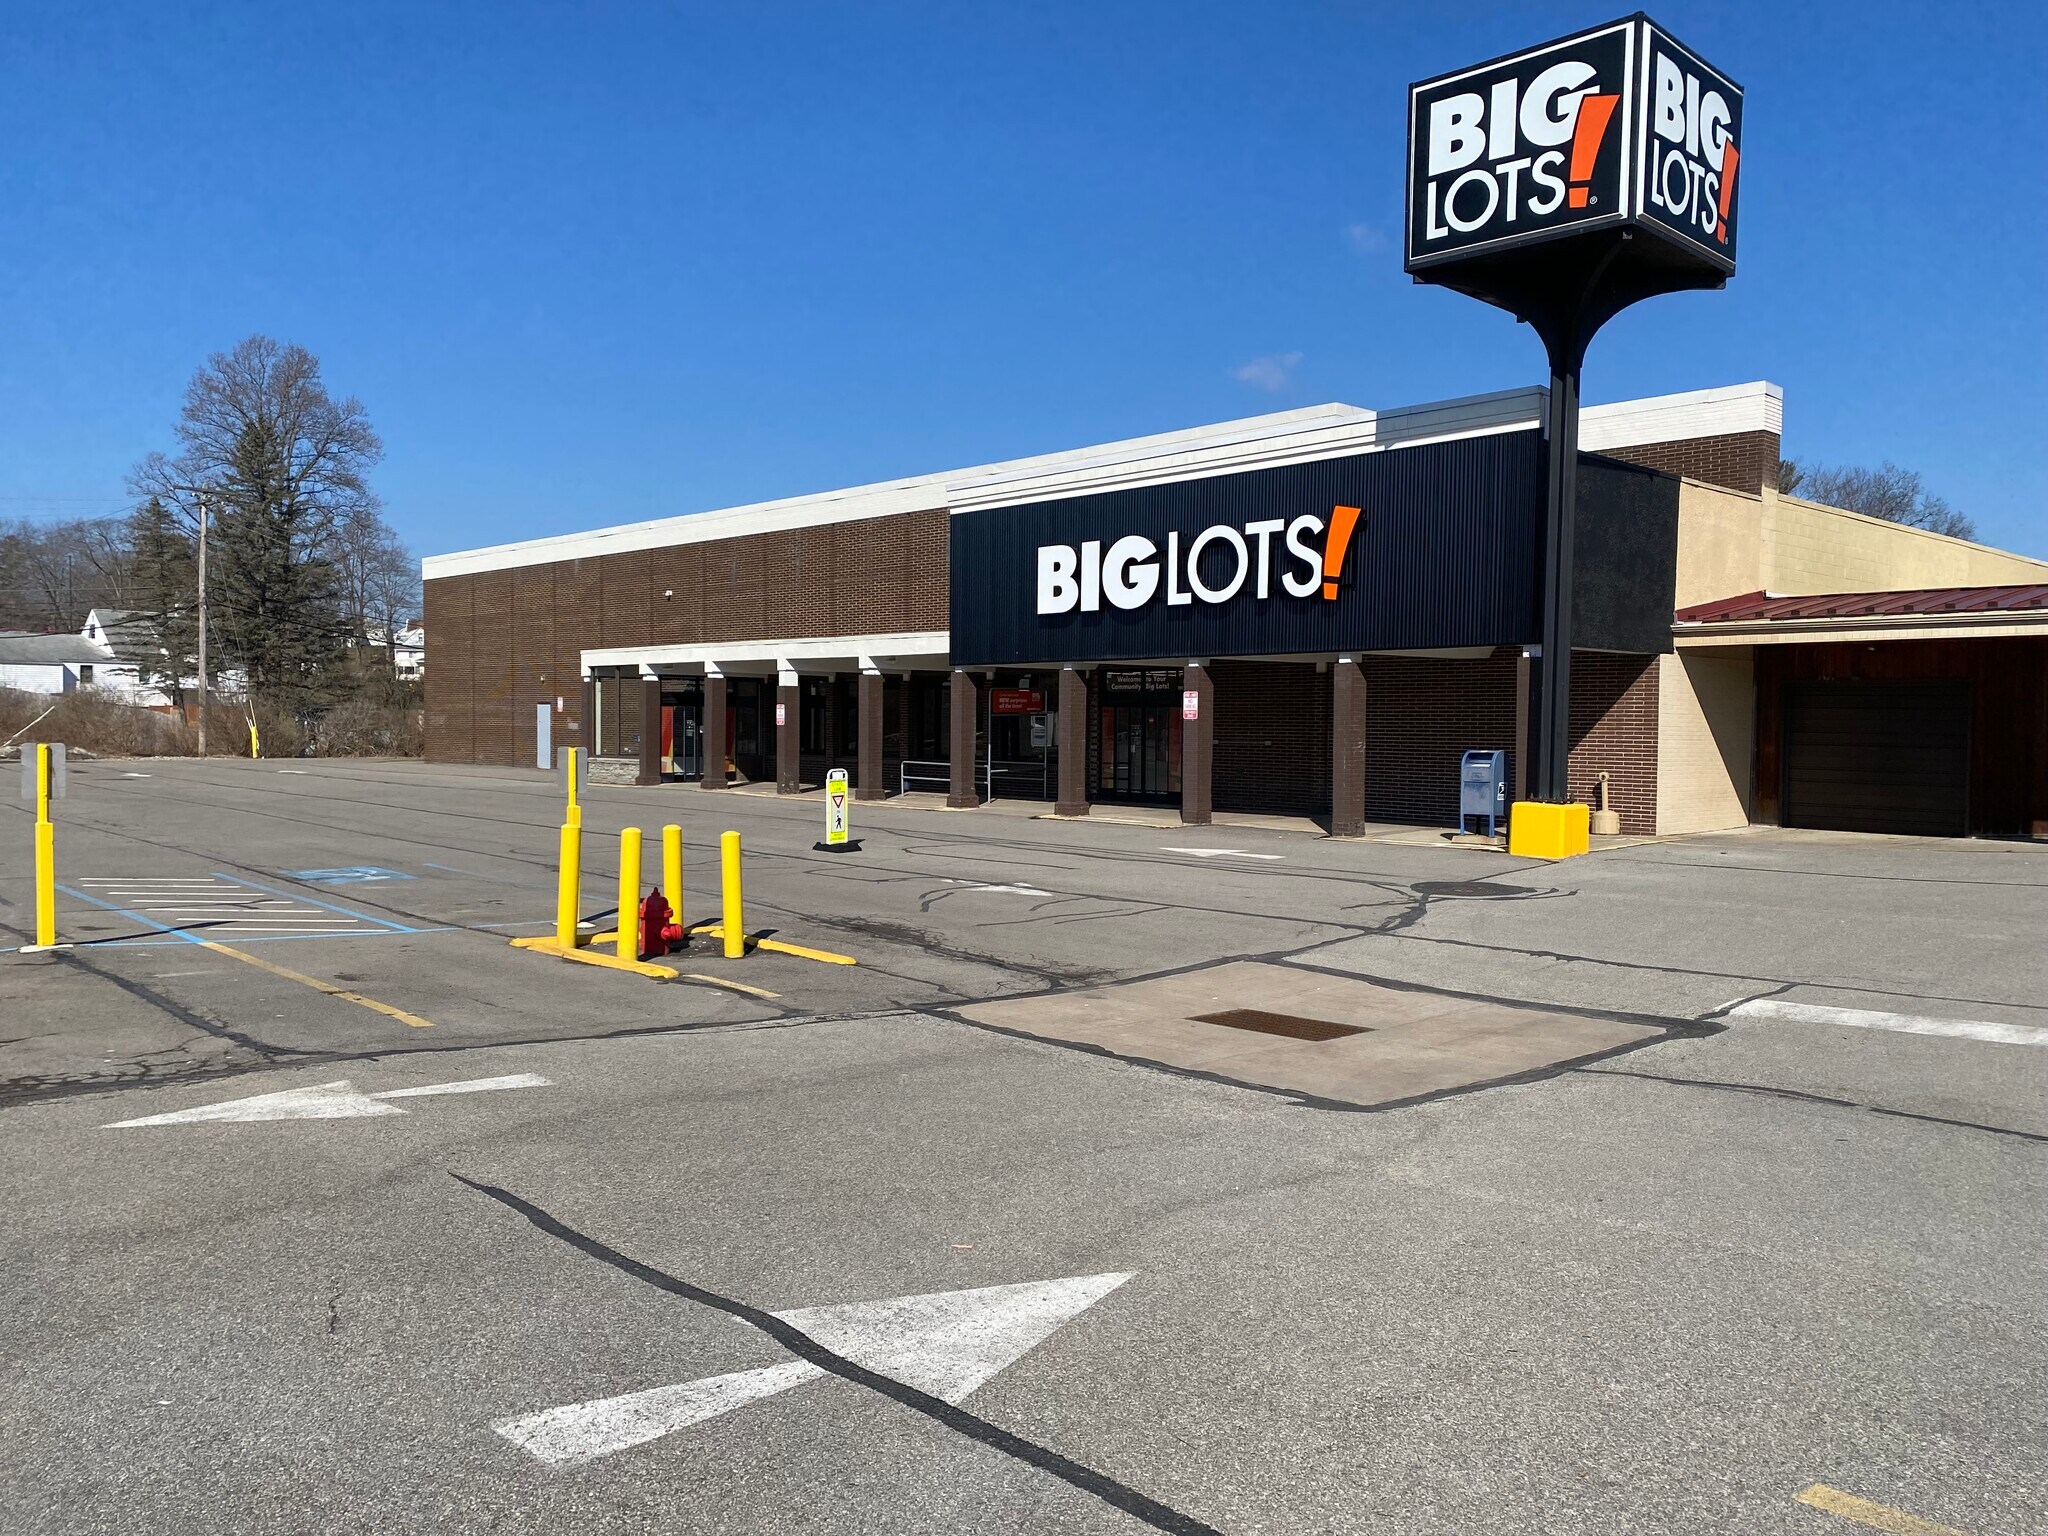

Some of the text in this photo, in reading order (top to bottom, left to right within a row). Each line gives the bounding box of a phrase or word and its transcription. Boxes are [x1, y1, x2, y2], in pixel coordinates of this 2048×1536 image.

[1426, 94, 1620, 240] LOTS!
[1428, 61, 1600, 177] BIG
[1655, 51, 1733, 172] BIG
[1651, 137, 1739, 245] LOTS!
[1037, 505, 1361, 615] BIG LOTS!
[1111, 683, 1141, 691] Community
[1145, 683, 1155, 691] Big
